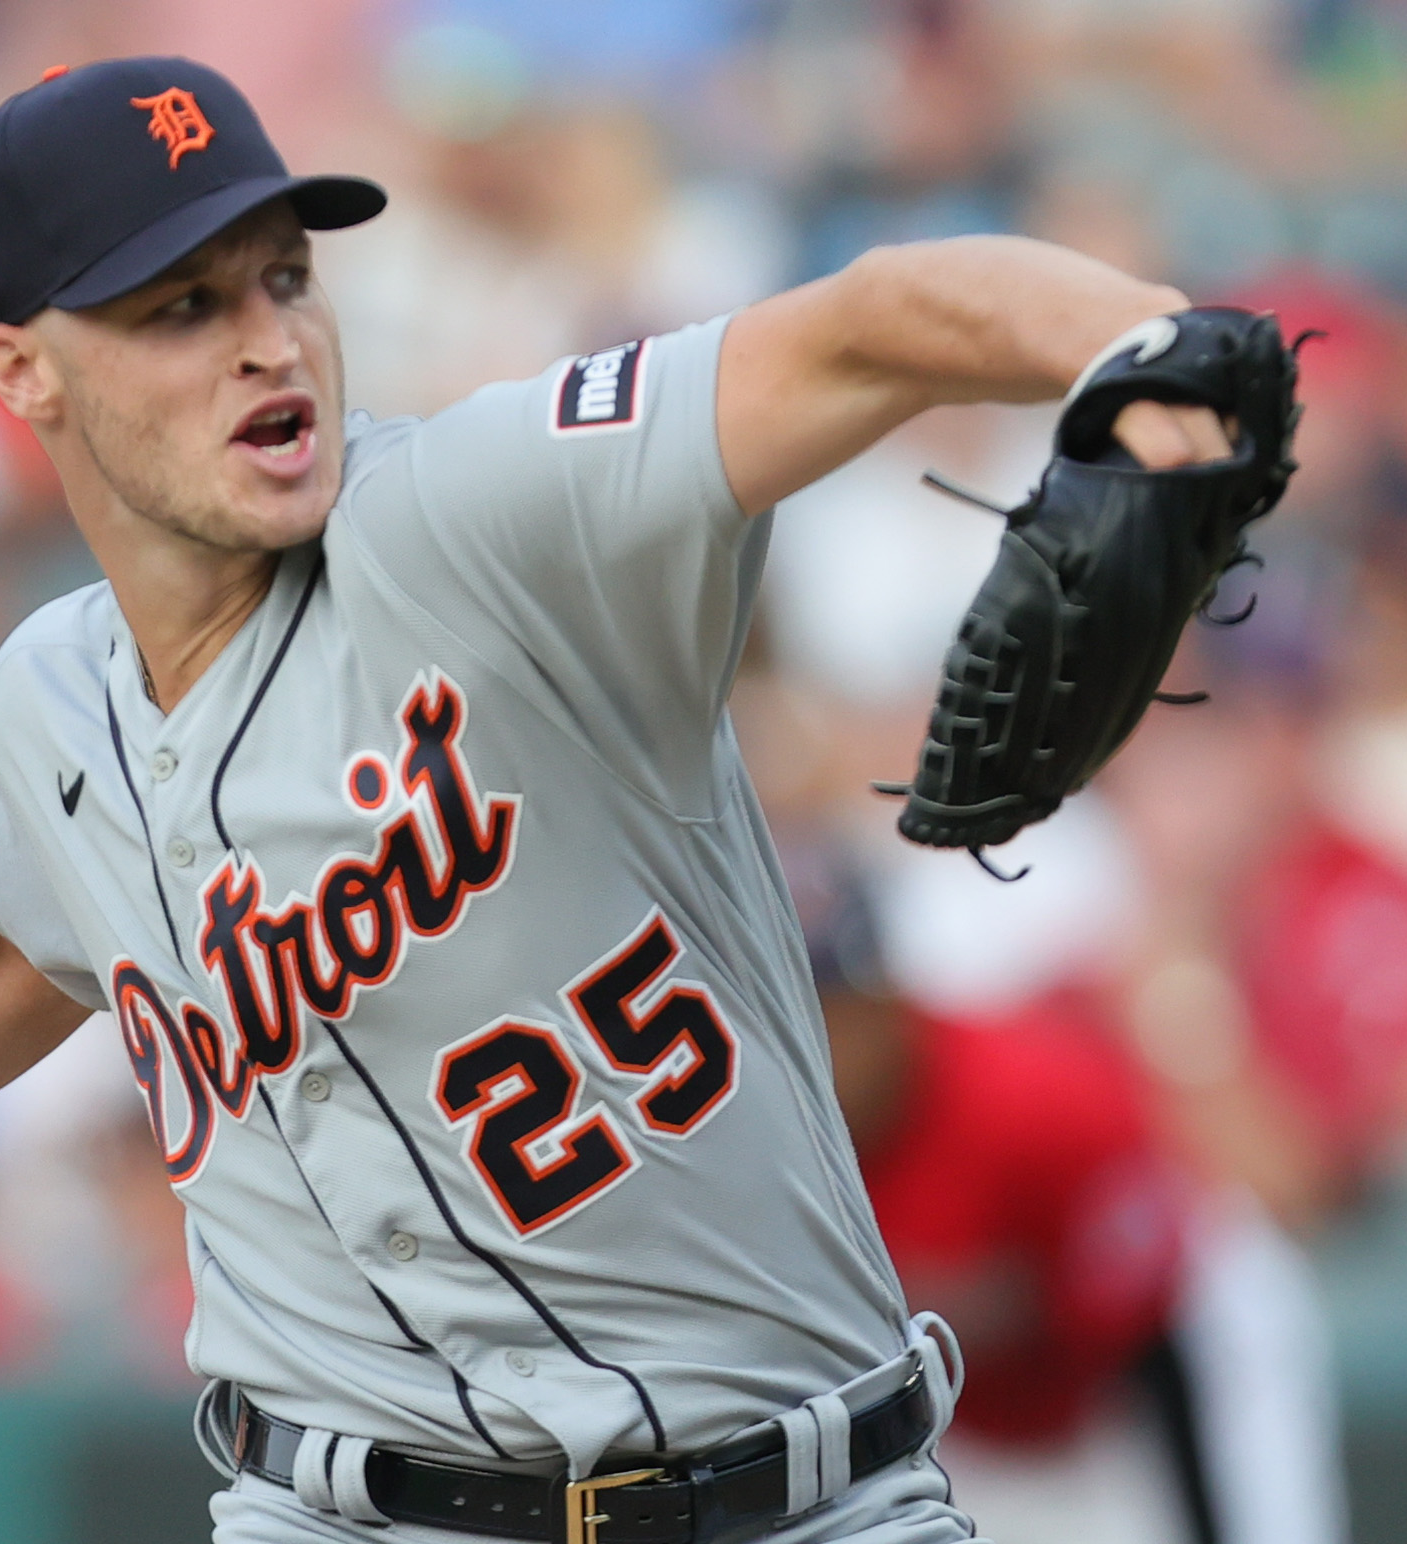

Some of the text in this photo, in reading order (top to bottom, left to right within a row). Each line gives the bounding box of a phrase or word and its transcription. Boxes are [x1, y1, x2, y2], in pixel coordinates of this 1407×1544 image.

[130, 86, 217, 172] D
[576, 340, 639, 421] mei
[111, 664, 523, 1190] Detroit
[427, 905, 742, 1242] 25
